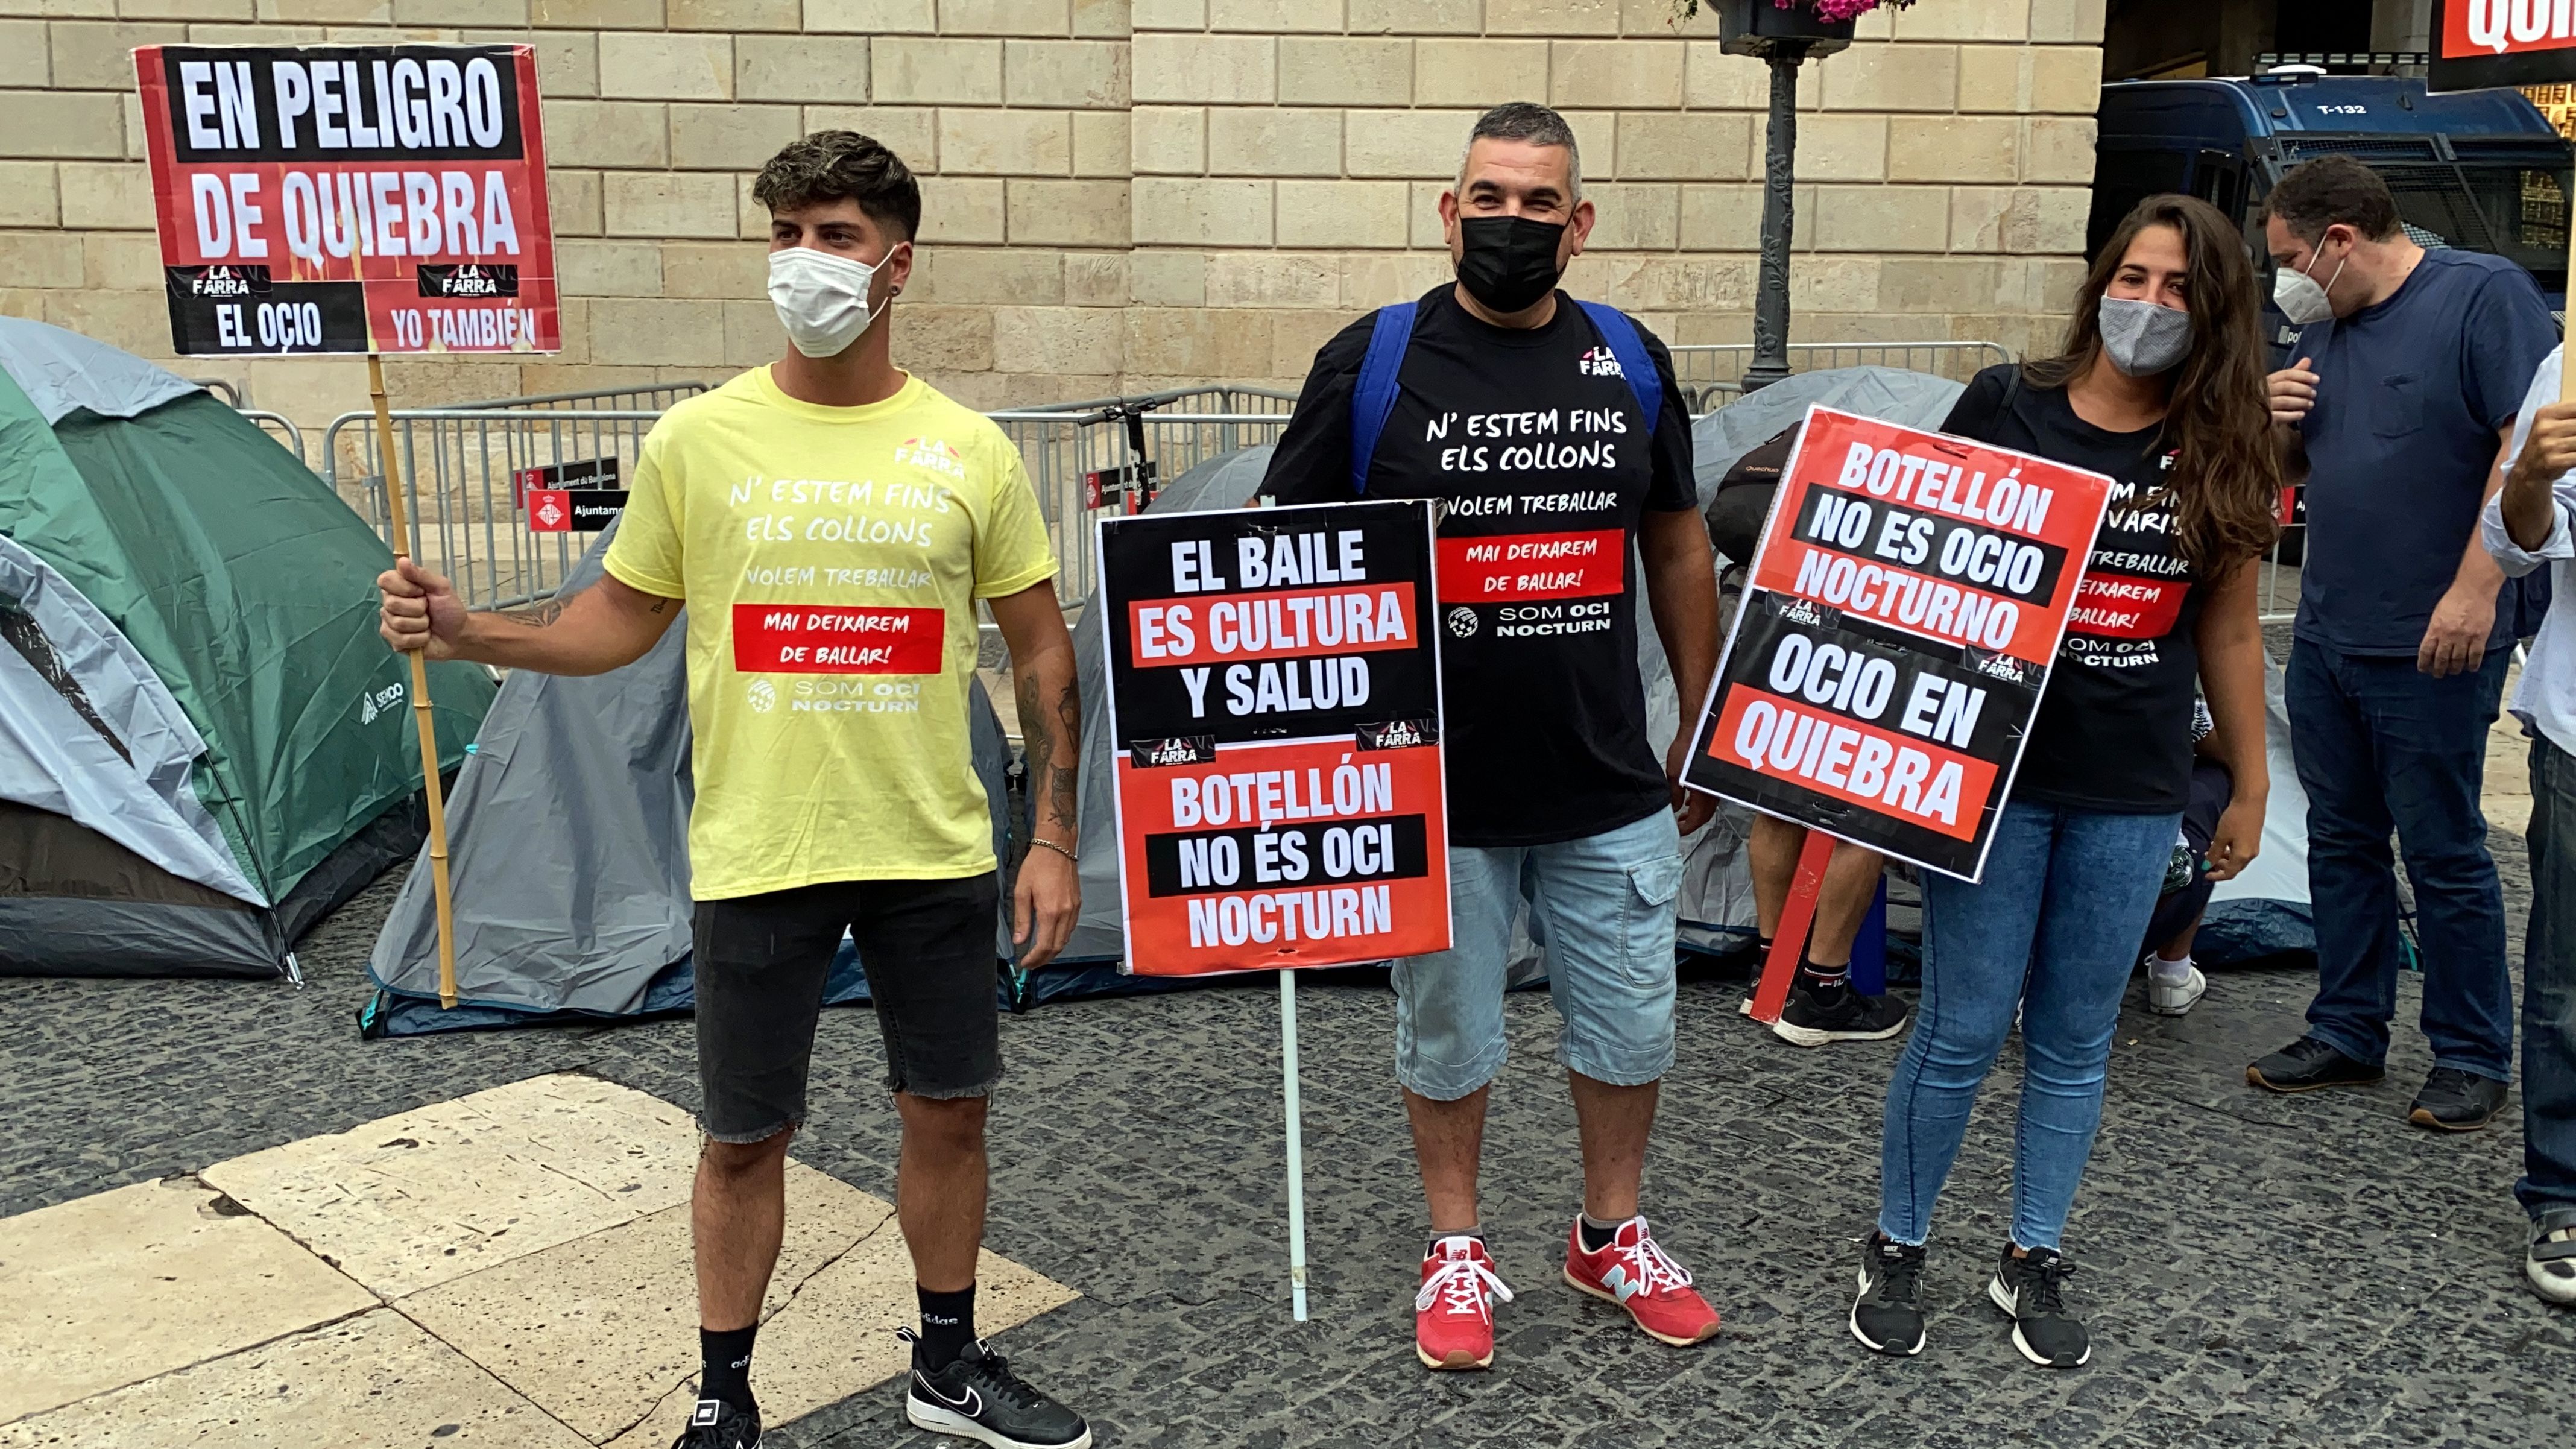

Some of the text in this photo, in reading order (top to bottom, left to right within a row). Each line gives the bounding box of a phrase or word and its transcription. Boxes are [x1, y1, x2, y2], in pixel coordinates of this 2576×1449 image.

[180, 58, 503, 149] EN PELIGRO
[2317, 105, 2367, 115] T-132
[191, 171, 519, 270] DE QUIEBRA
[209, 265, 230, 280] LA
[458, 265, 479, 279] LA
[192, 280, 249, 294] FARRA
[443, 279, 497, 293] FARRA
[216, 304, 252, 347] EL
[391, 298, 535, 347] YO TAMBIÉN
[1570, 408, 1627, 434] FINS
[919, 436, 945, 456] LA
[1441, 440, 1616, 472] ELS COLLONS
[895, 447, 965, 479] FARRA
[884, 482, 951, 513] FINS
[1837, 441, 2054, 535] BOTELLÓN
[1448, 490, 1617, 516] VOLEM TREBALLAR
[747, 514, 933, 547] ELS COLLONS
[2107, 508, 2183, 536] VARIS
[1466, 538, 1597, 563] MAI DEIXAREM
[1808, 492, 2045, 595] NO ES OCIO
[1171, 529, 1366, 593] EL BAILE
[2089, 550, 2189, 576] TREBALLAR
[747, 566, 932, 589] VOLEM TREBALLAR
[1484, 569, 1584, 593] DE BALLAR!
[1793, 548, 2019, 651] NOCTURNO
[2079, 579, 2161, 603] EIXAREM
[1499, 602, 1610, 621] SOM OCI
[1779, 605, 1821, 627] FARRA
[1795, 598, 1812, 612] LA
[763, 612, 910, 633] MAI DEIXAREM
[1138, 591, 1407, 658] ES CULTURA
[1497, 619, 1611, 637] NOCTURN
[2069, 607, 2140, 629] BALLAR!
[780, 645, 892, 665] DE BALLAR!
[2068, 638, 2155, 653] OM OCI
[1978, 659, 2024, 683] FARRA
[1996, 653, 2014, 668] LA
[795, 681, 920, 695] SOM OCI
[1180, 657, 1369, 718] Y SALUD
[1768, 633, 1987, 748] OCIO EN
[791, 699, 919, 713] NOCTURN
[1375, 732, 1421, 747] FARRA
[1389, 721, 1407, 734] LA
[1151, 748, 1196, 764] FARRA
[1164, 738, 1182, 751] LA
[1734, 701, 1965, 826] QUIEBRA
[1170, 753, 1393, 827] BOTELLÓN
[1178, 821, 1394, 888] NO ÉS OCI
[1187, 885, 1392, 948] NOCTURN
